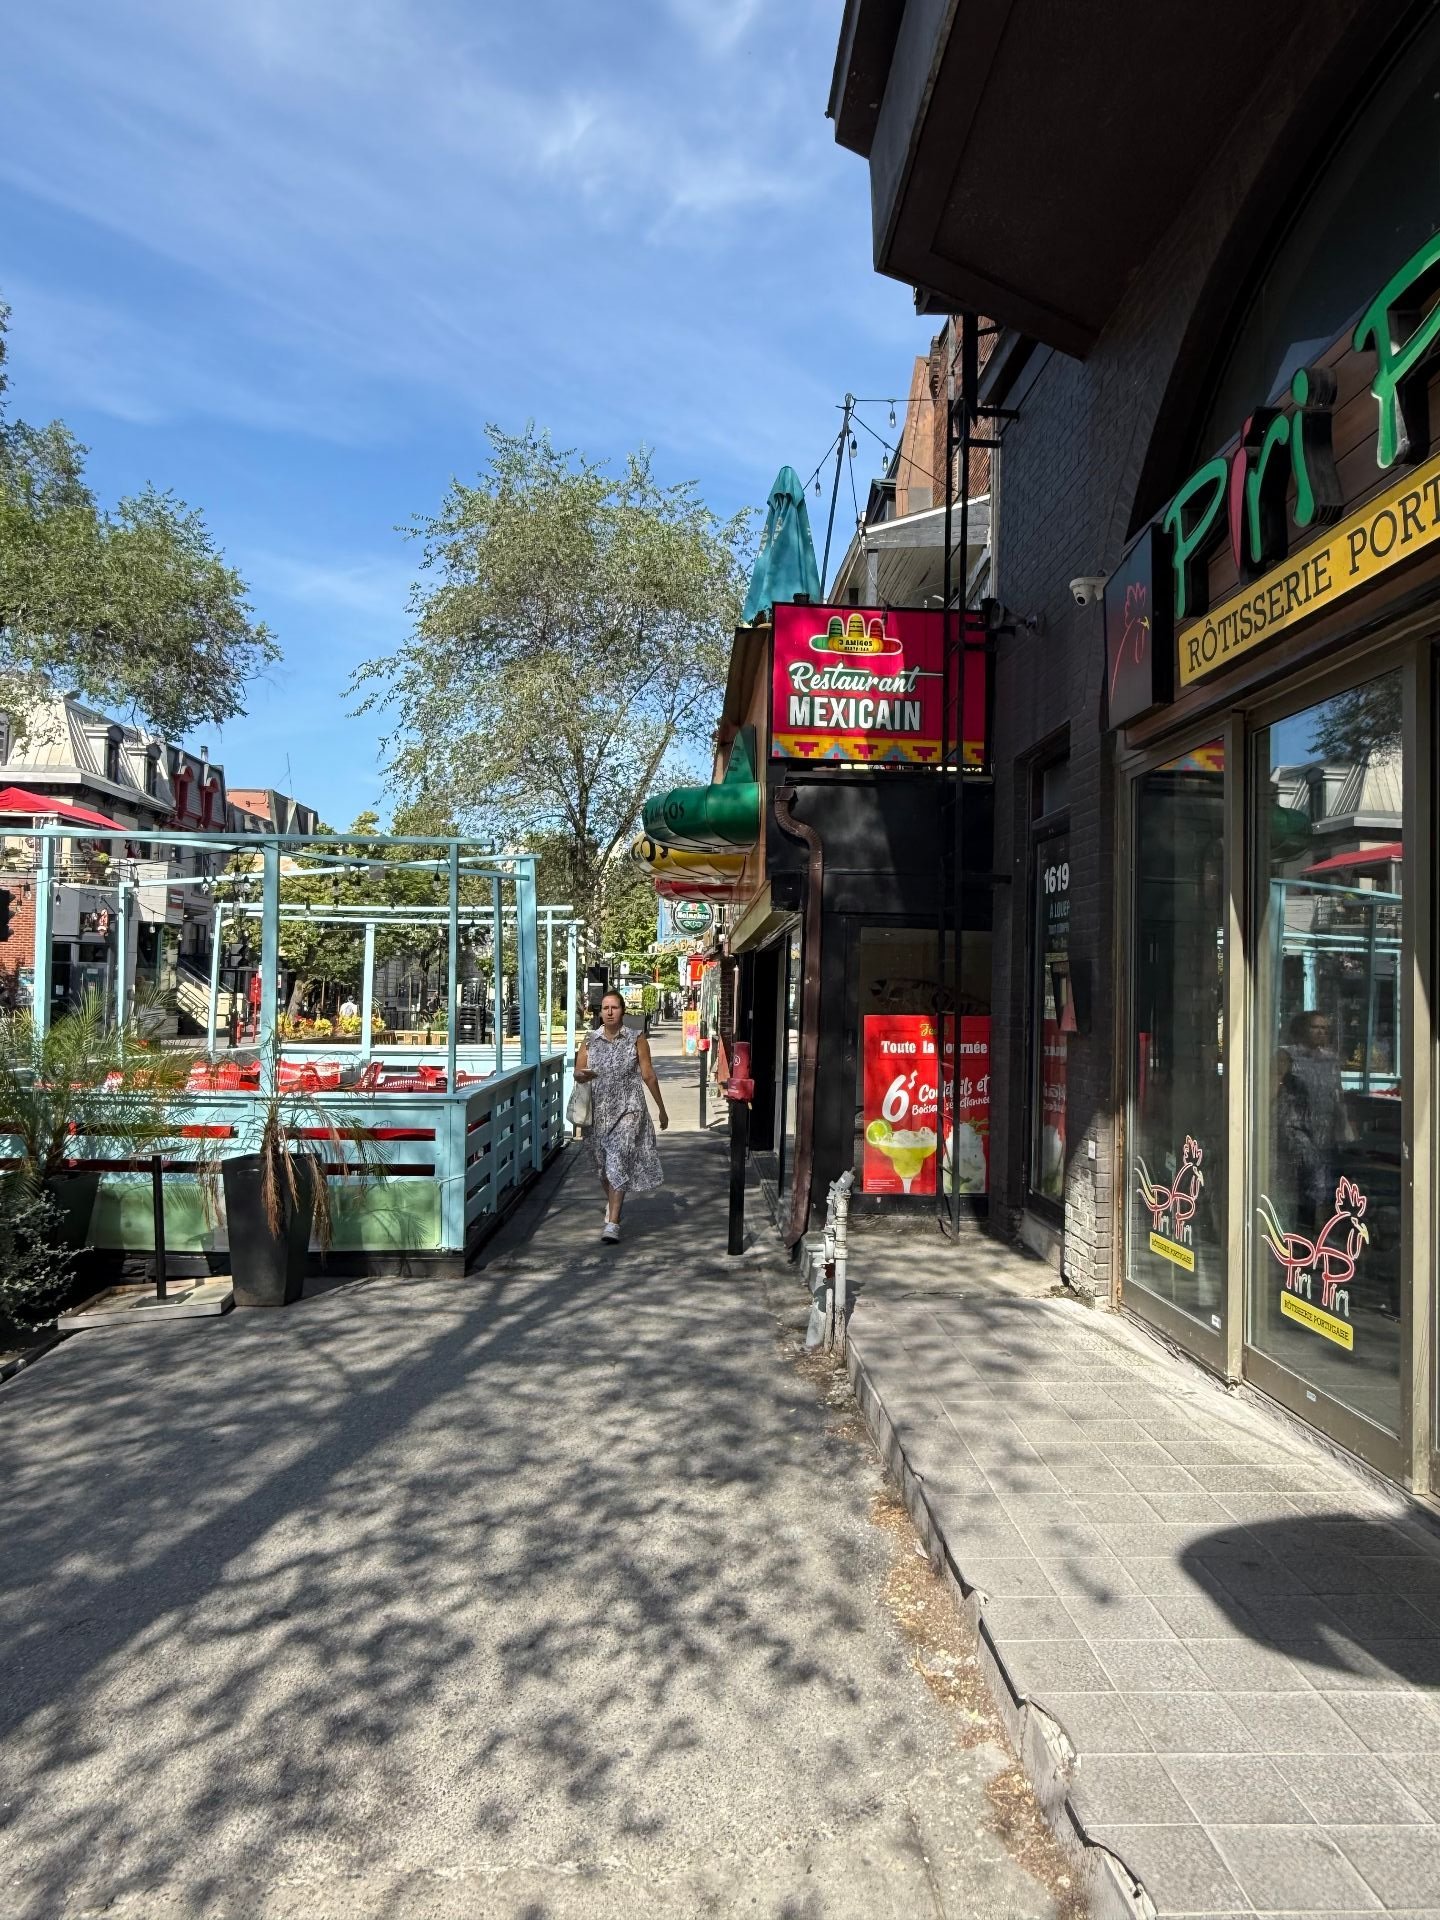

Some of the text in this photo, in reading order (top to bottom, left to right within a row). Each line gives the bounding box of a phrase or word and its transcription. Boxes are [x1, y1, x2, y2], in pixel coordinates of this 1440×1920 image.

[1187, 548, 1333, 673] RÔTISSERIE
[789, 662, 943, 693] Restaurant
[789, 695, 920, 731] MEXICAIN
[1044, 862, 1070, 894] 1619
[881, 1040, 916, 1054] Toute
[922, 1040, 935, 1054] la
